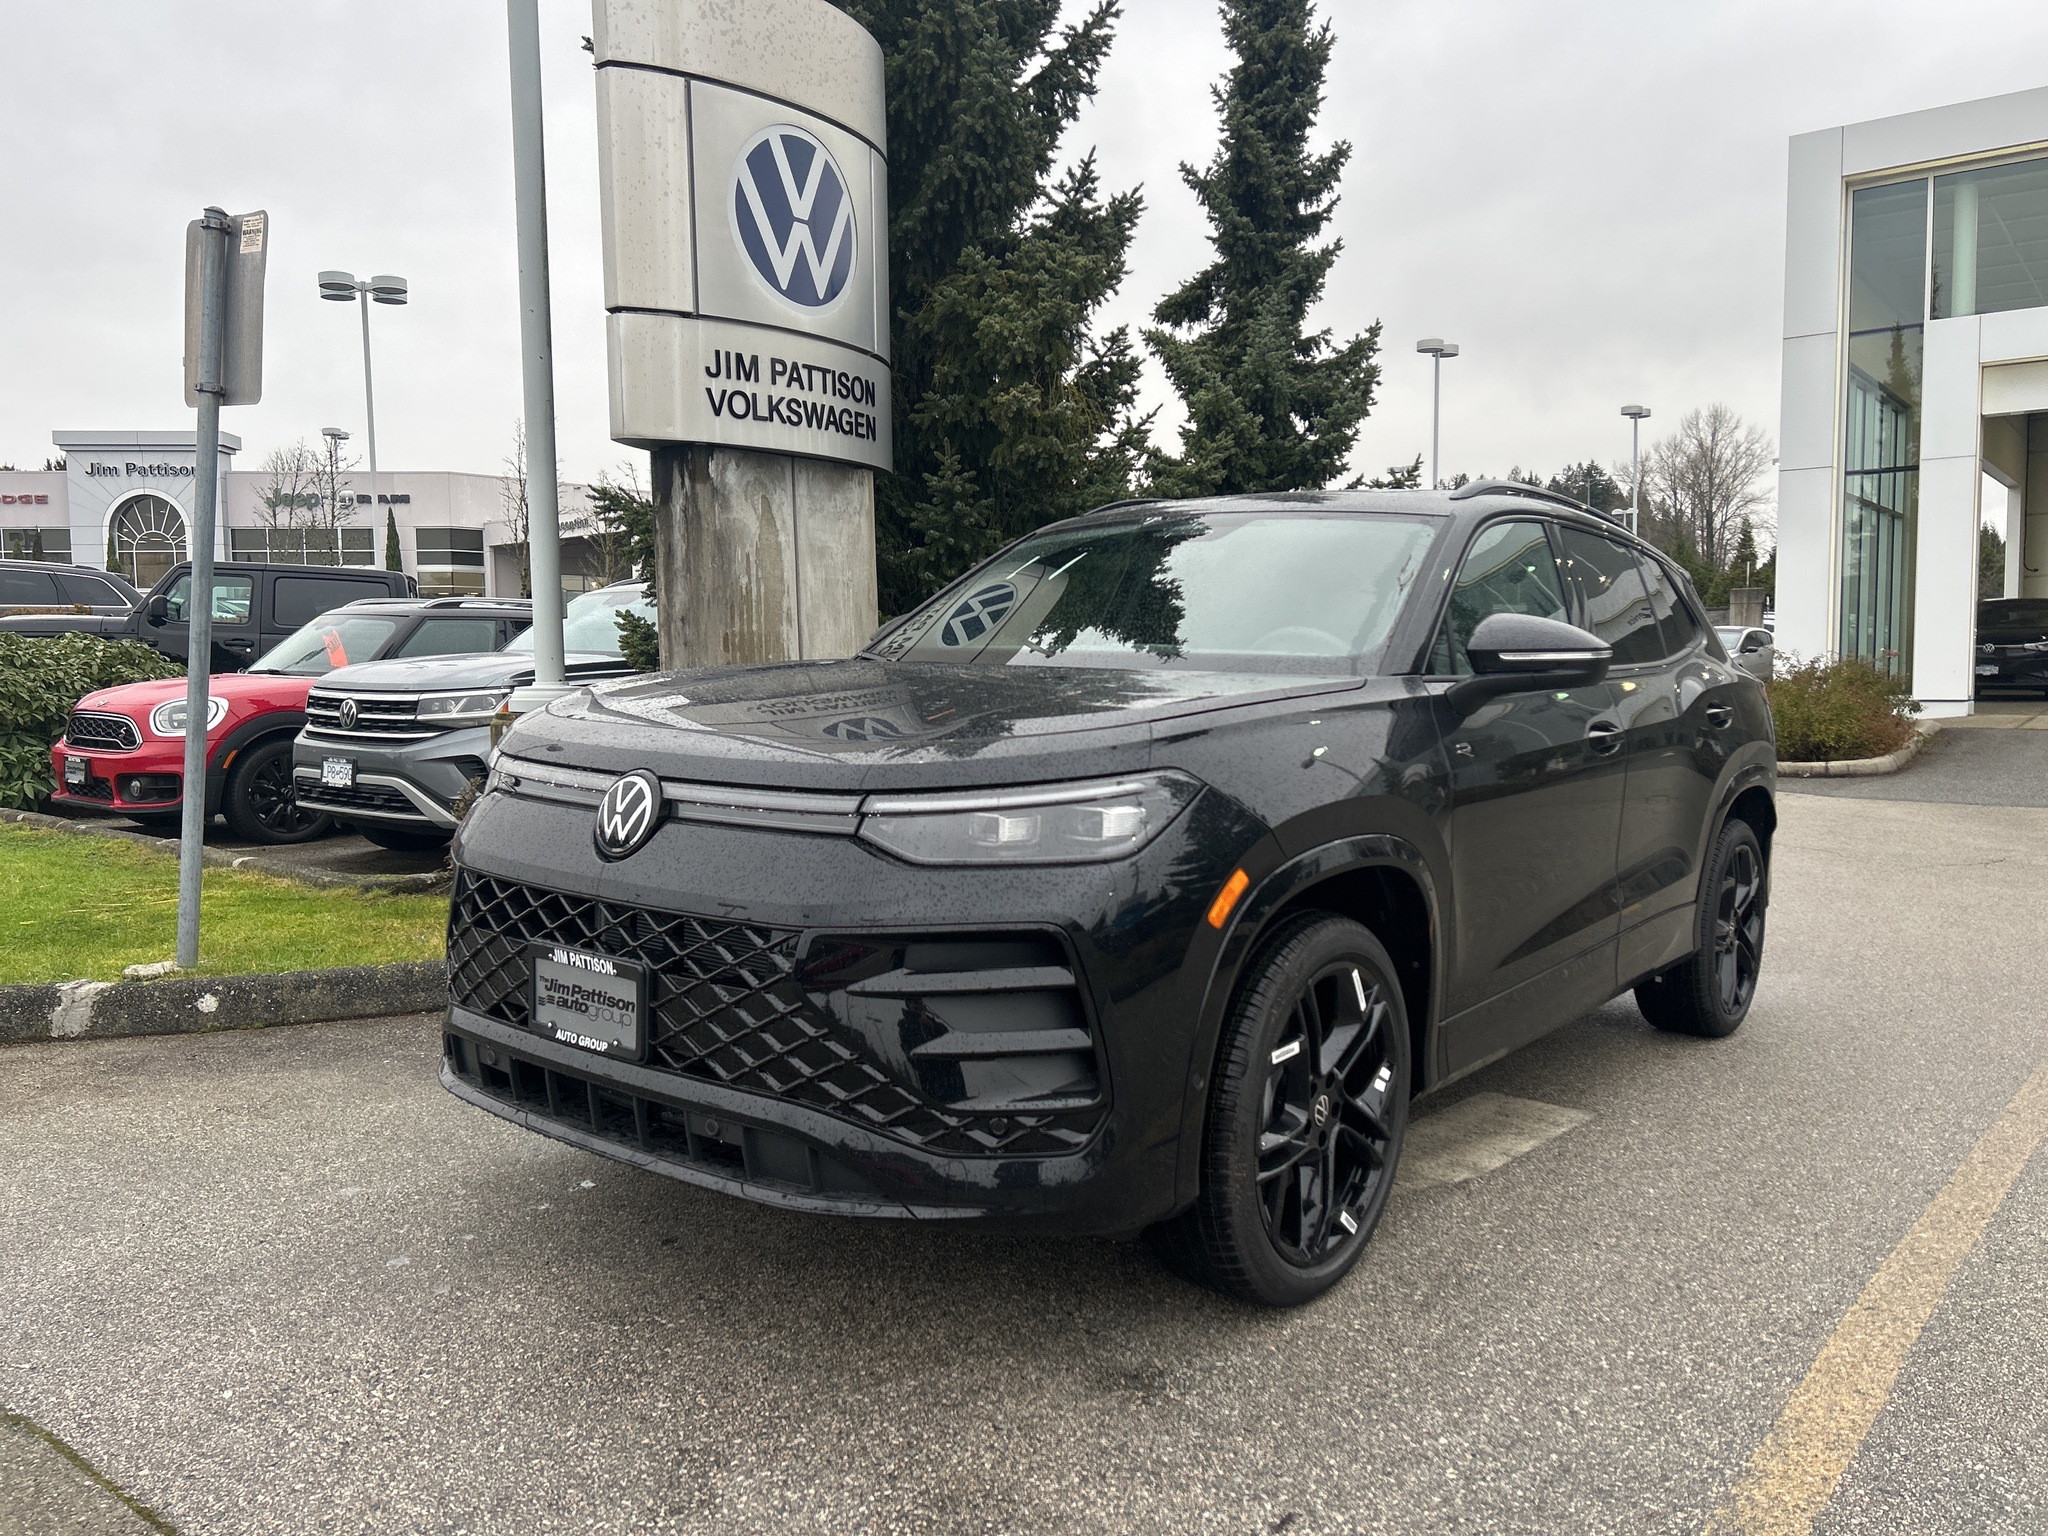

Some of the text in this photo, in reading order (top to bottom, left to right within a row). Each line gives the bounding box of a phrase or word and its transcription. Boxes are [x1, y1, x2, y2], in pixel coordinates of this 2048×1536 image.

[705, 349, 876, 407] JIM PATTISON
[705, 387, 877, 442] VOLKSWAGEN
[85, 462, 119, 477] Jim
[0, 493, 48, 505] DGE
[552, 948, 614, 976] JIM PATTISON
[555, 1029, 609, 1052] AUTO GROUP
